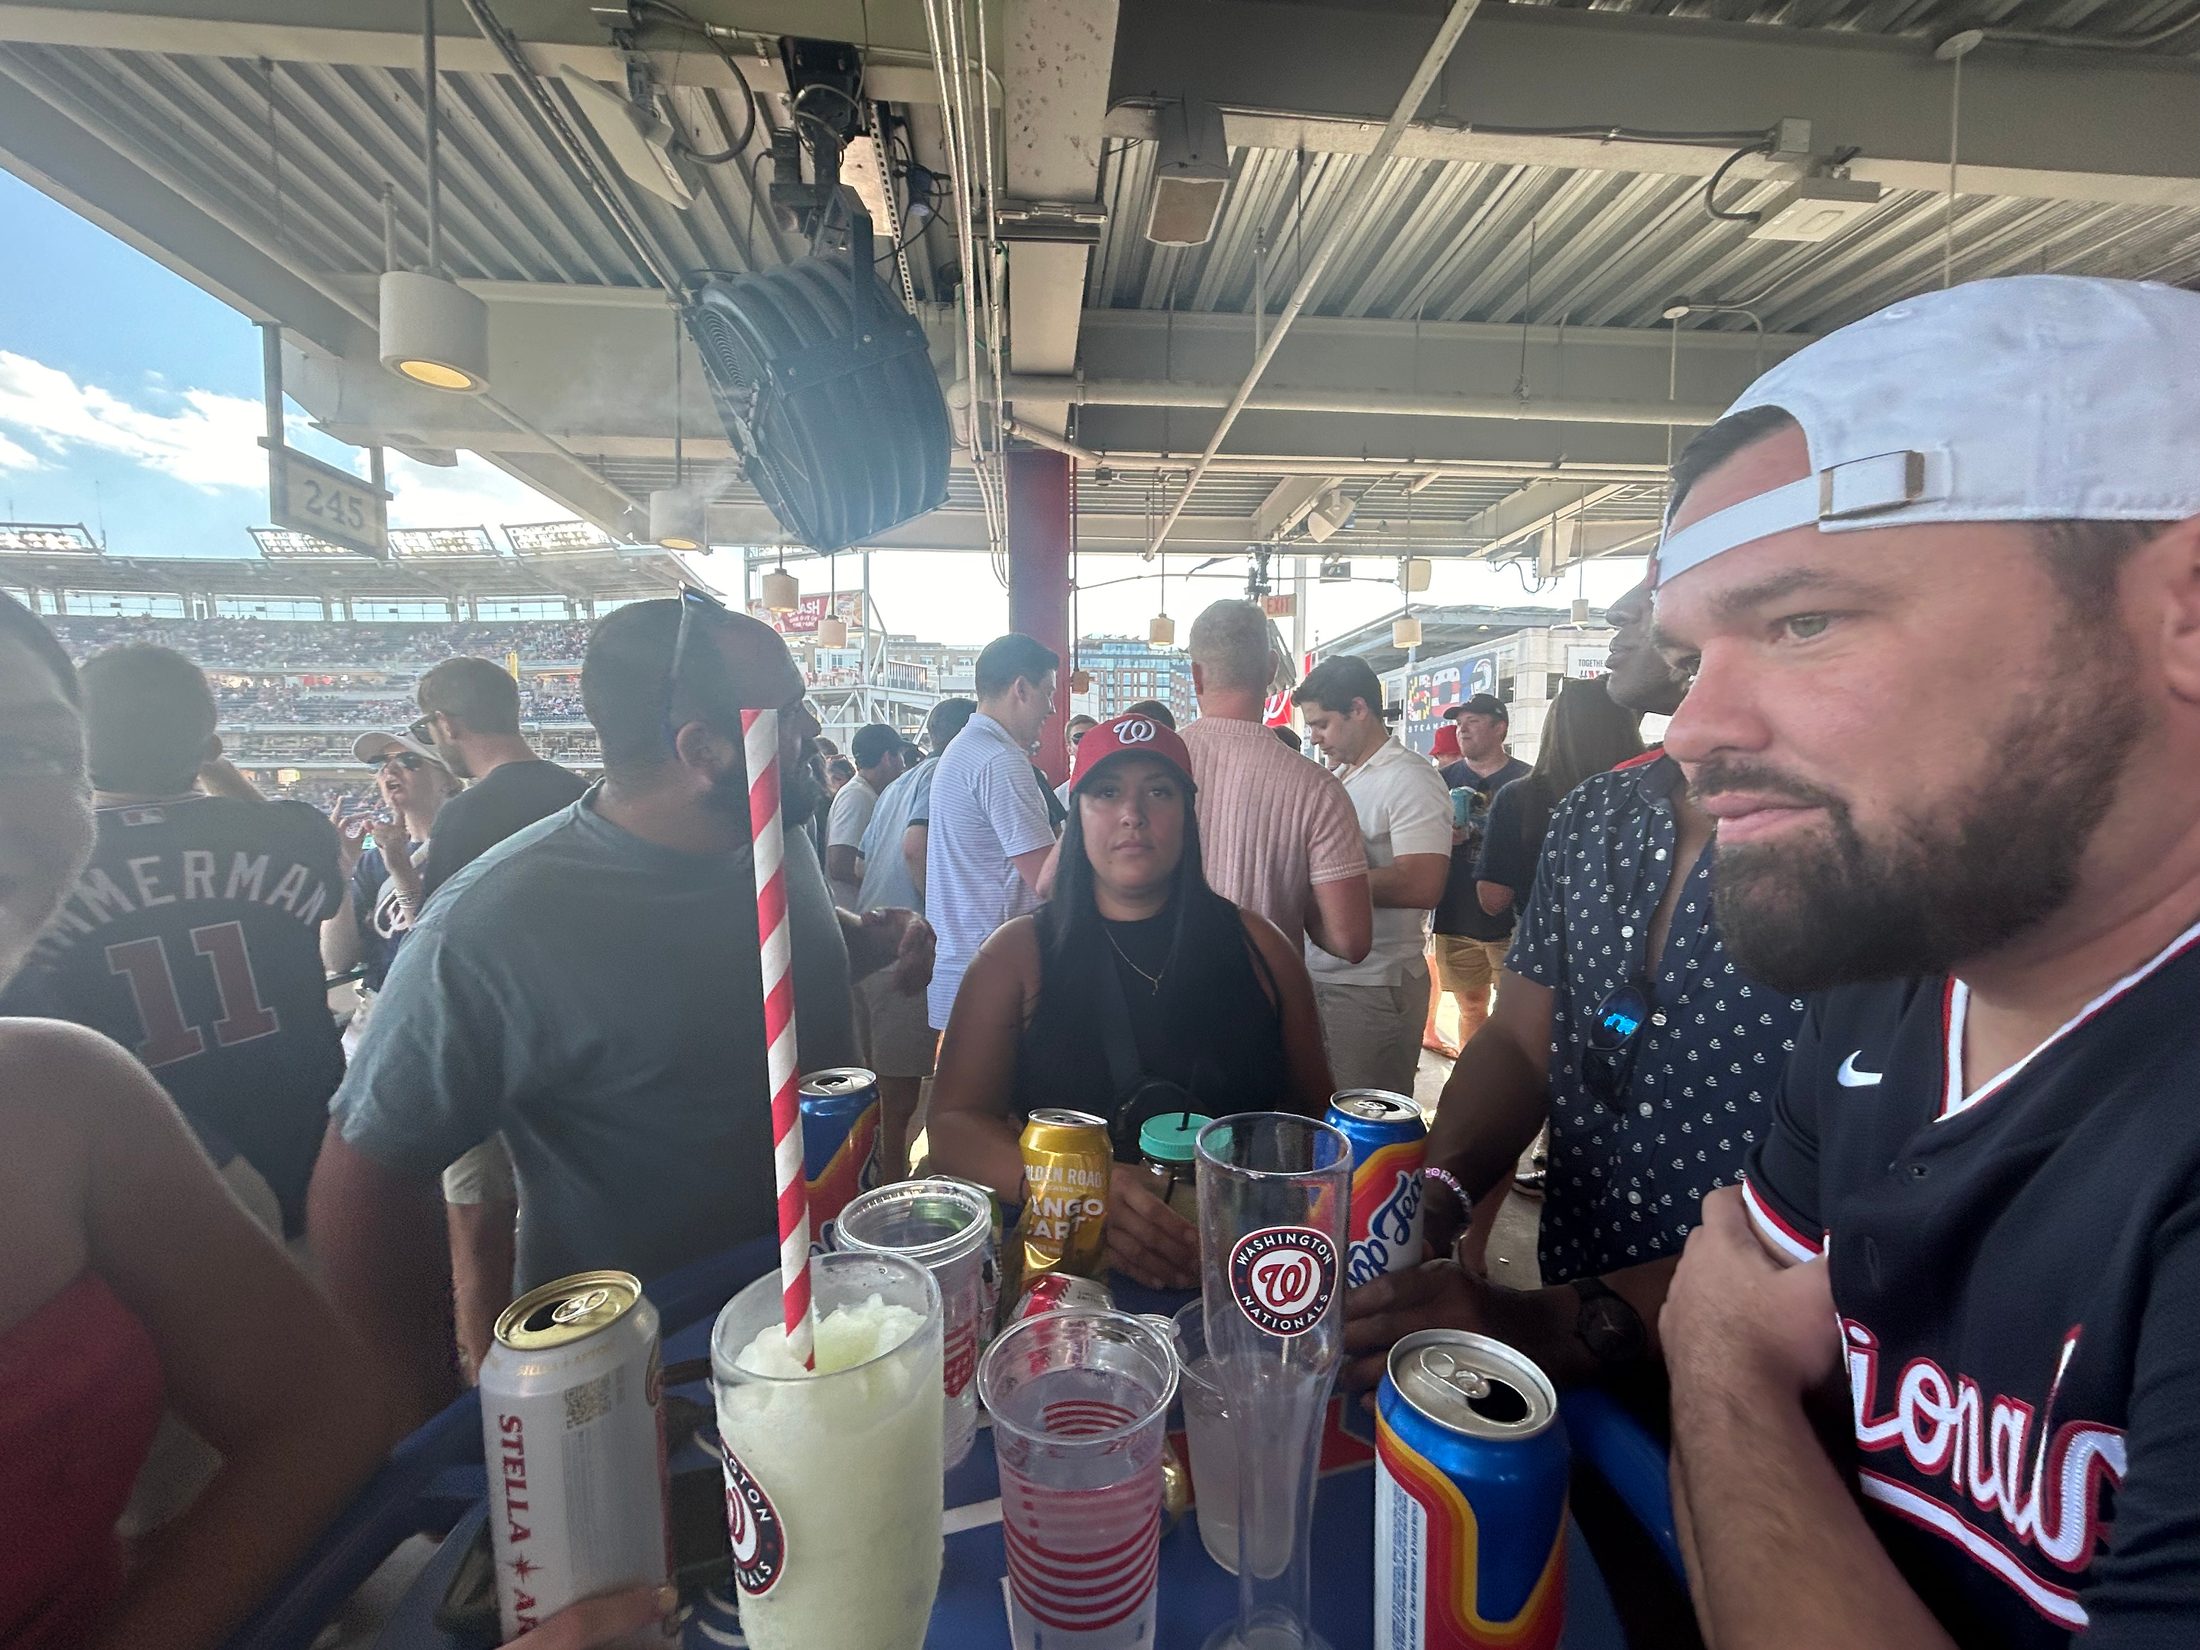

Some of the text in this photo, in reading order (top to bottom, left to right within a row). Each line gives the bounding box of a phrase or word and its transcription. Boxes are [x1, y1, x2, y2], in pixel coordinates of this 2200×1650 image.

[303, 480, 364, 529] 245
[1267, 598, 1288, 614] EXIT
[1578, 659, 1605, 667] TOGETHE
[1113, 719, 1156, 744] W
[104, 920, 280, 1068] 11
[1024, 1164, 1102, 1188] OLDEN ROAD
[1031, 1194, 1104, 1218] ANGO
[1372, 1173, 1423, 1246] Tea
[1236, 1233, 1333, 1266] WASHINGTON
[1257, 1256, 1312, 1307] W
[1241, 1294, 1328, 1330] NATIONALS
[498, 1414, 532, 1545] STELLA
